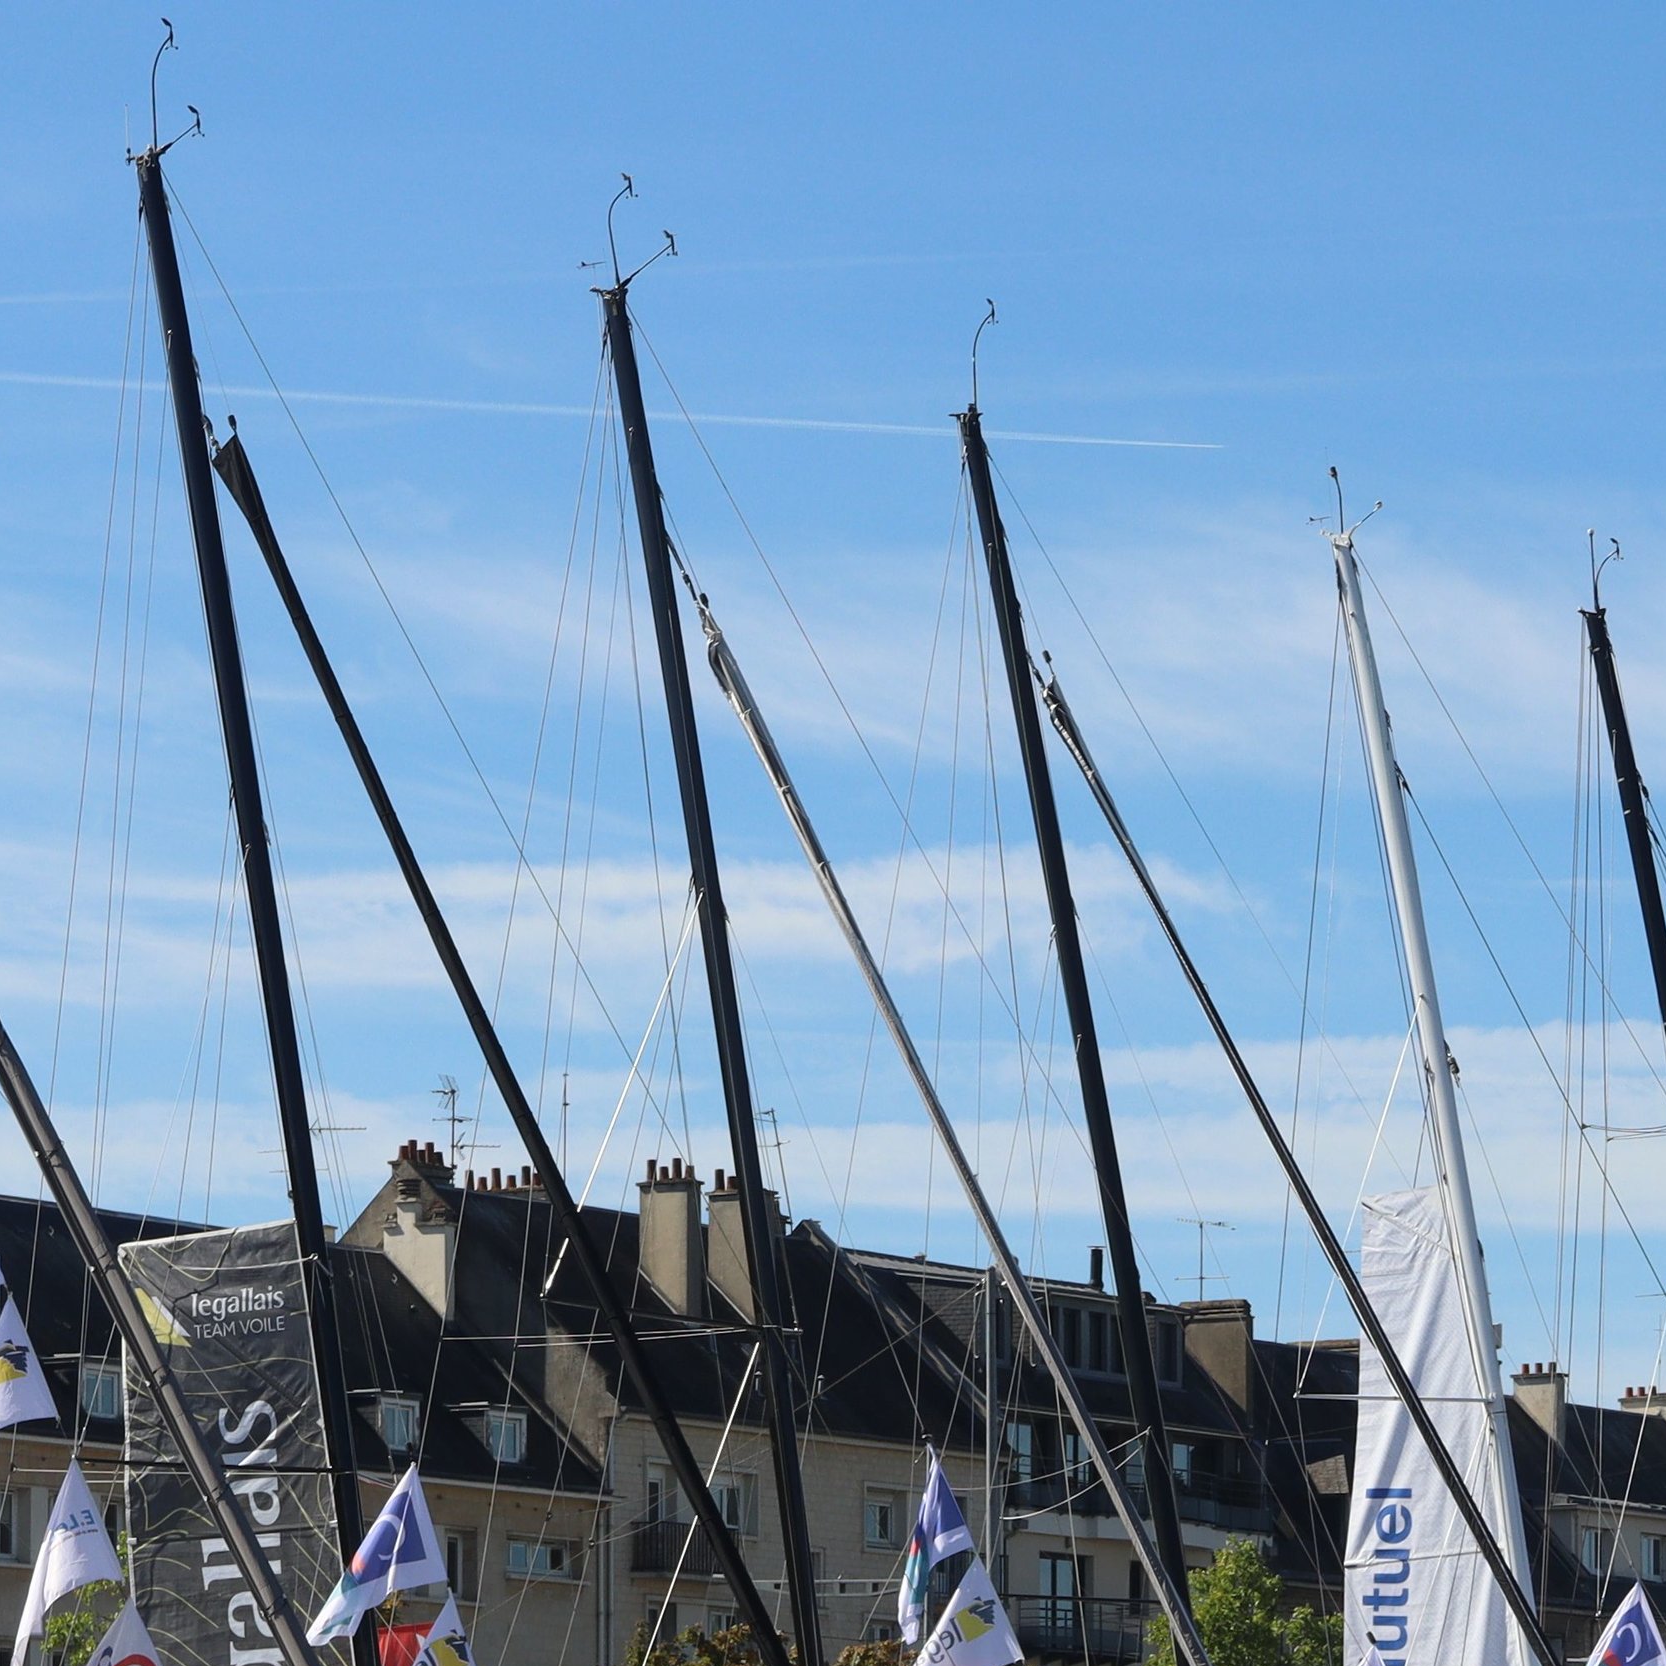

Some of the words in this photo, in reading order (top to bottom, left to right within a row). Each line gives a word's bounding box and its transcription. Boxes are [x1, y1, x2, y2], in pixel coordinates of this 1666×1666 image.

[191, 1286, 284, 1322] legallais
[194, 1322, 236, 1339] TEAM
[239, 1316, 286, 1334] VOILE
